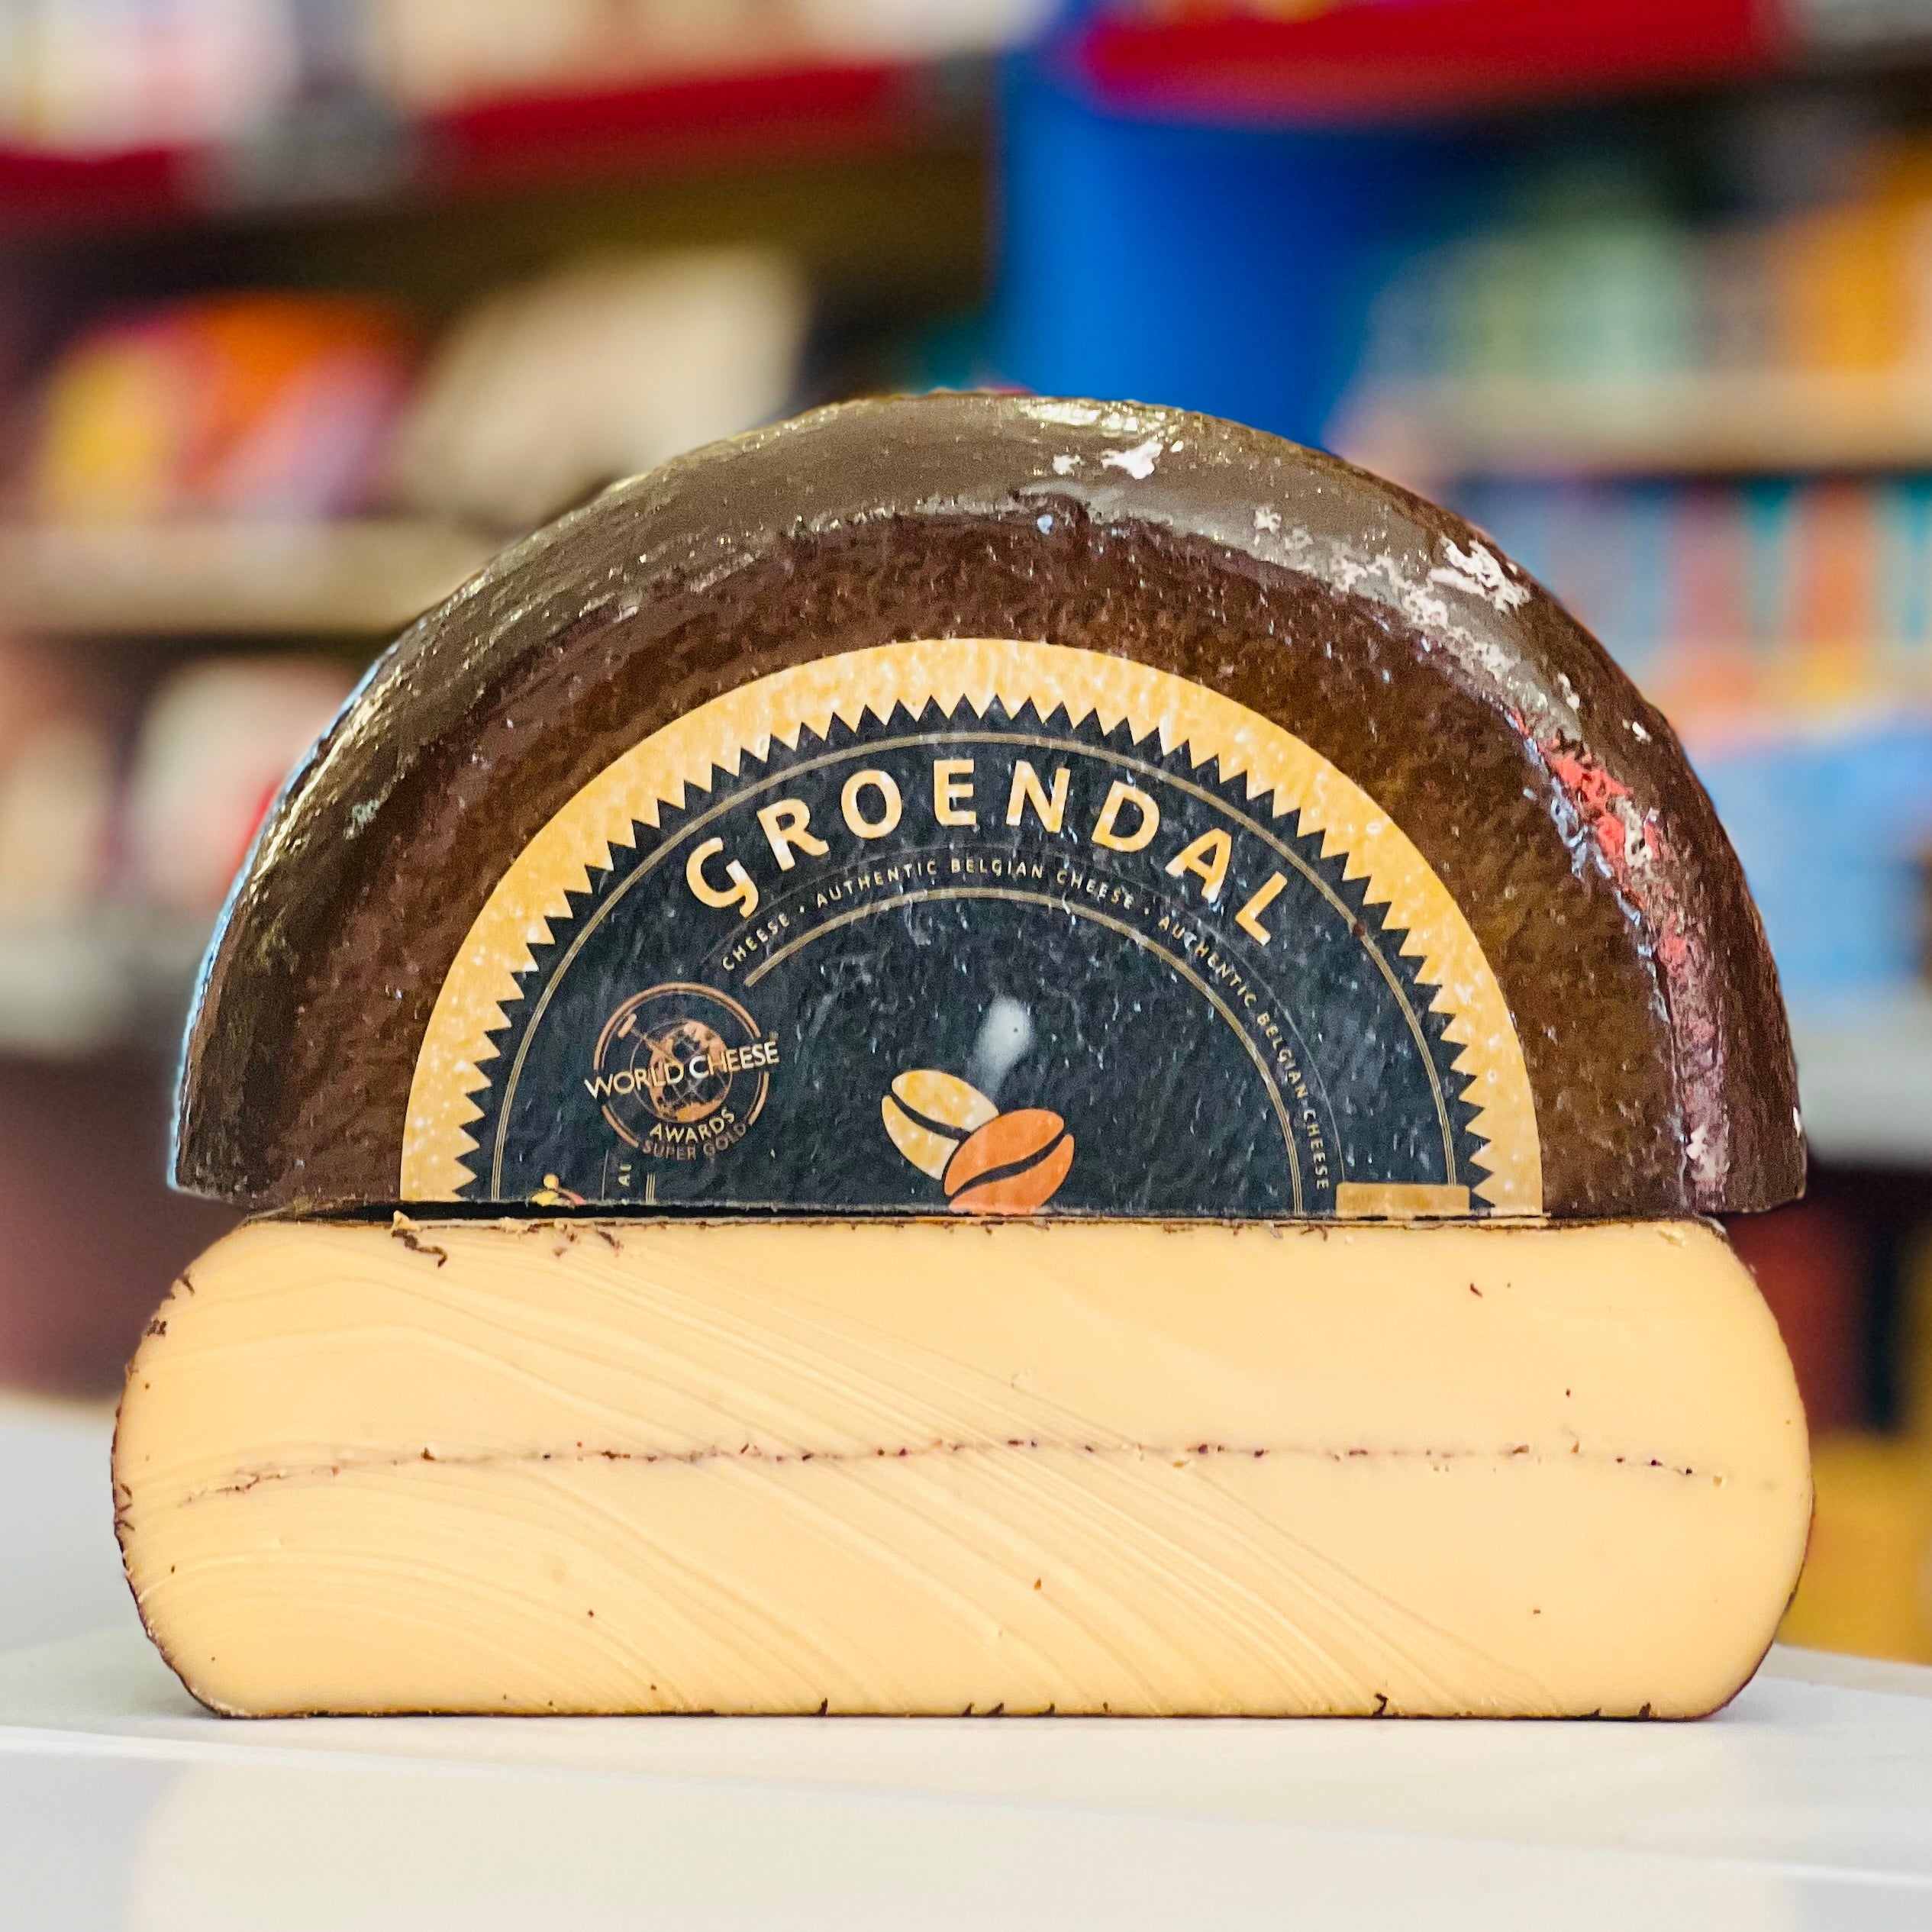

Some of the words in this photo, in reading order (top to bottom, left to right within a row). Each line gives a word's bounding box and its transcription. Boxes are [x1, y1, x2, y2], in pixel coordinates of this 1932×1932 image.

[685, 760, 1288, 947] GROENDAL
[722, 913, 790, 971] CHEESE
[817, 858, 937, 908] AUTHENTIC
[951, 857, 1043, 878] BELGIAN
[1056, 869, 1134, 910] CHEESE
[1158, 916, 1257, 1008] AUTHENTIC
[1256, 1013, 1308, 1099] BELGIAN
[1303, 1109, 1329, 1189] CHEESE
[584, 1063, 684, 1099] WORLD
[689, 1041, 779, 1079] CHEESE
[643, 1140, 696, 1161] SUPER
[703, 1122, 747, 1158] GOLD
[650, 1107, 735, 1143] AWARDS
